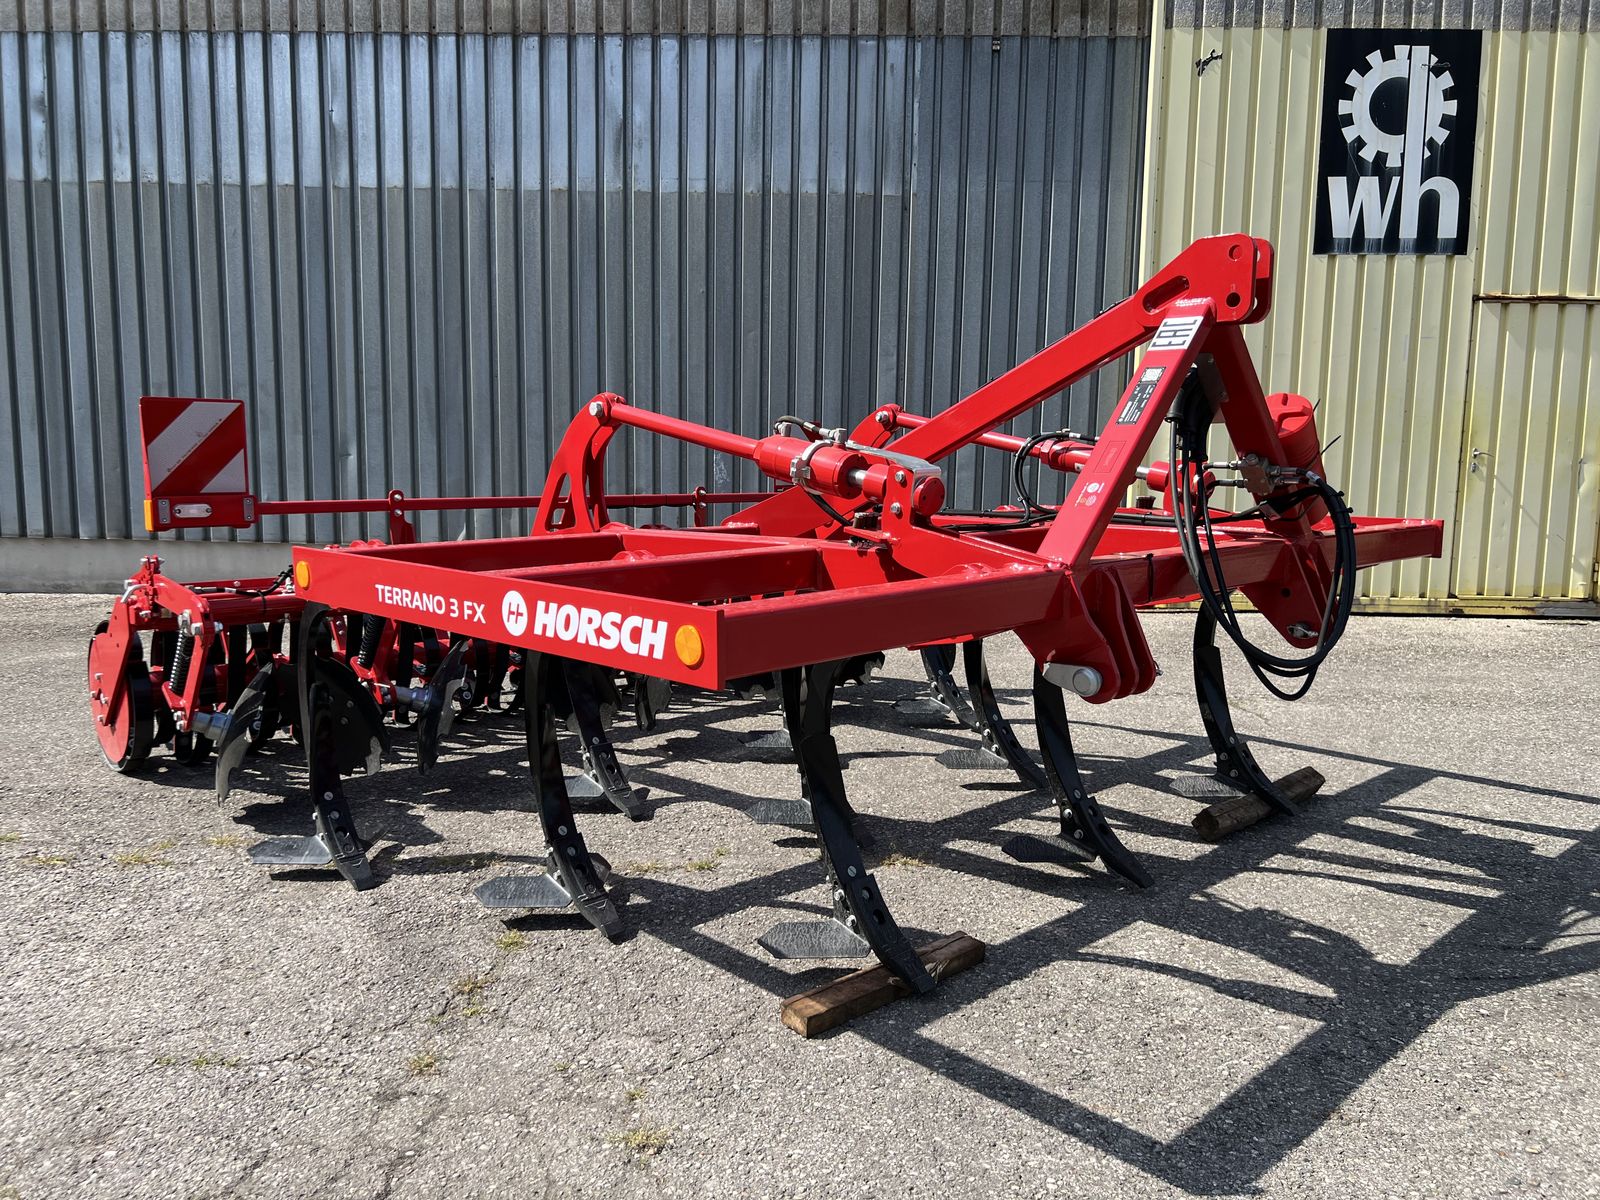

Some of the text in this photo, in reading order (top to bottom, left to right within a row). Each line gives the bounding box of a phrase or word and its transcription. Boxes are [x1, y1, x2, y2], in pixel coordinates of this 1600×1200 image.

[374, 583, 487, 624] TERRANO 3 FX
[533, 600, 668, 661] HORSCH
